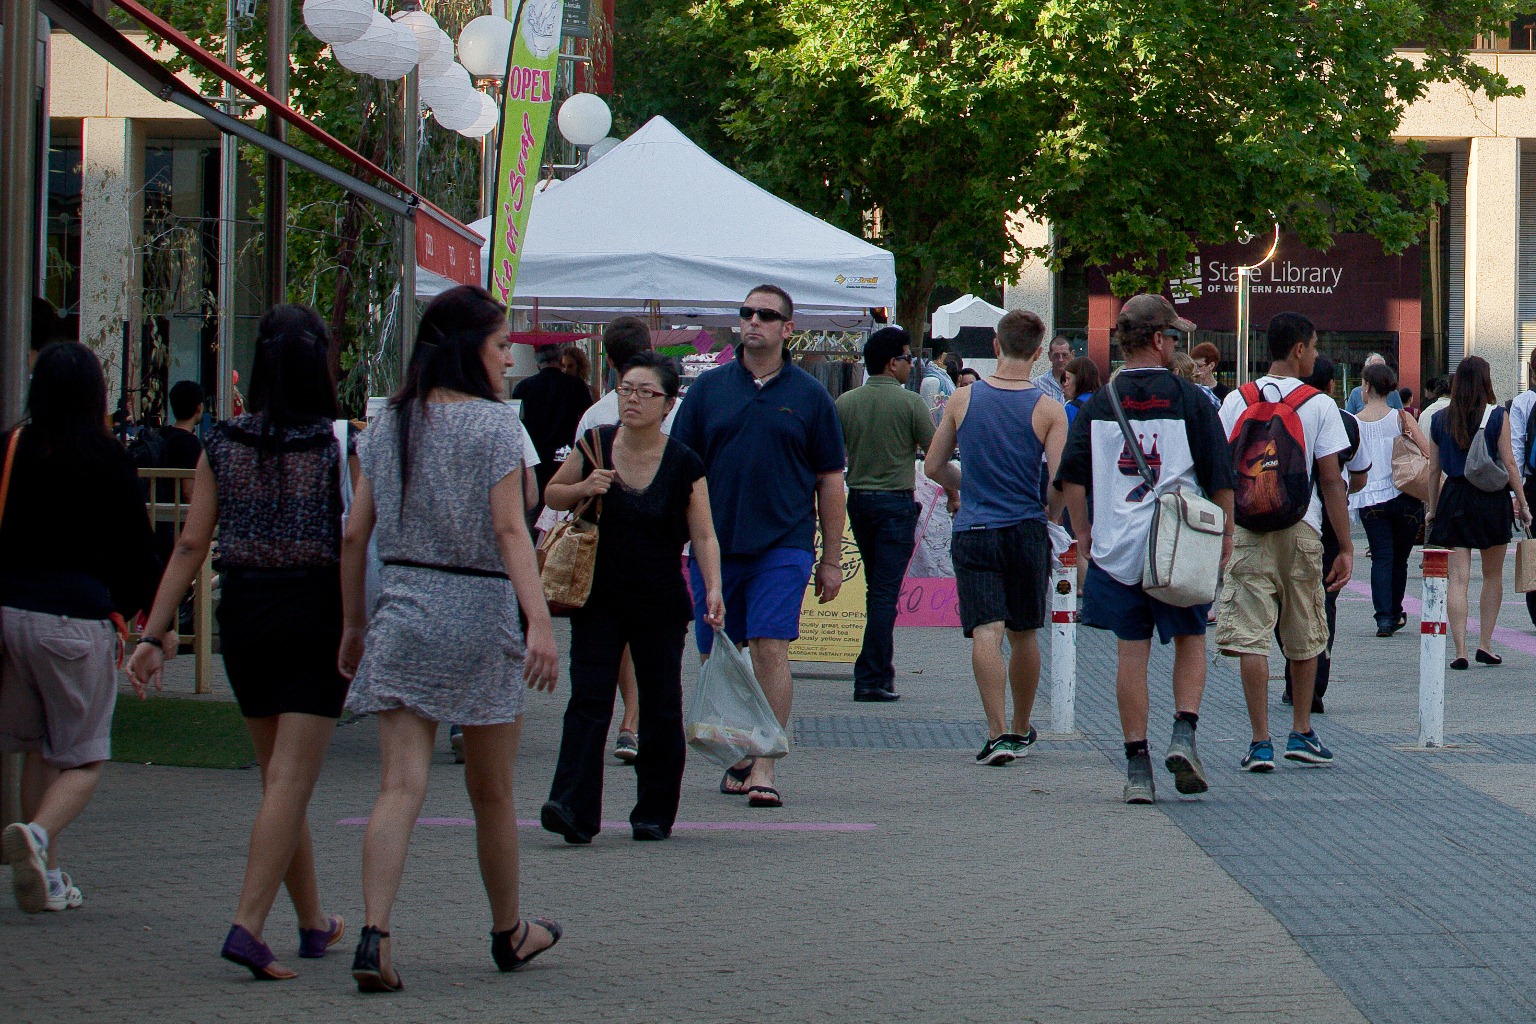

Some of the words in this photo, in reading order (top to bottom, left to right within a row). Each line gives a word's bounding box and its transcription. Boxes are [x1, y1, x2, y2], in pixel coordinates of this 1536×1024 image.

[510, 65, 552, 103] OPEN
[1208, 261, 1262, 282] Stae
[1271, 261, 1343, 288] Library
[1207, 284, 1221, 293] OF
[1224, 285, 1272, 294] WEERN
[1277, 285, 1333, 294] AUSTRALIA
